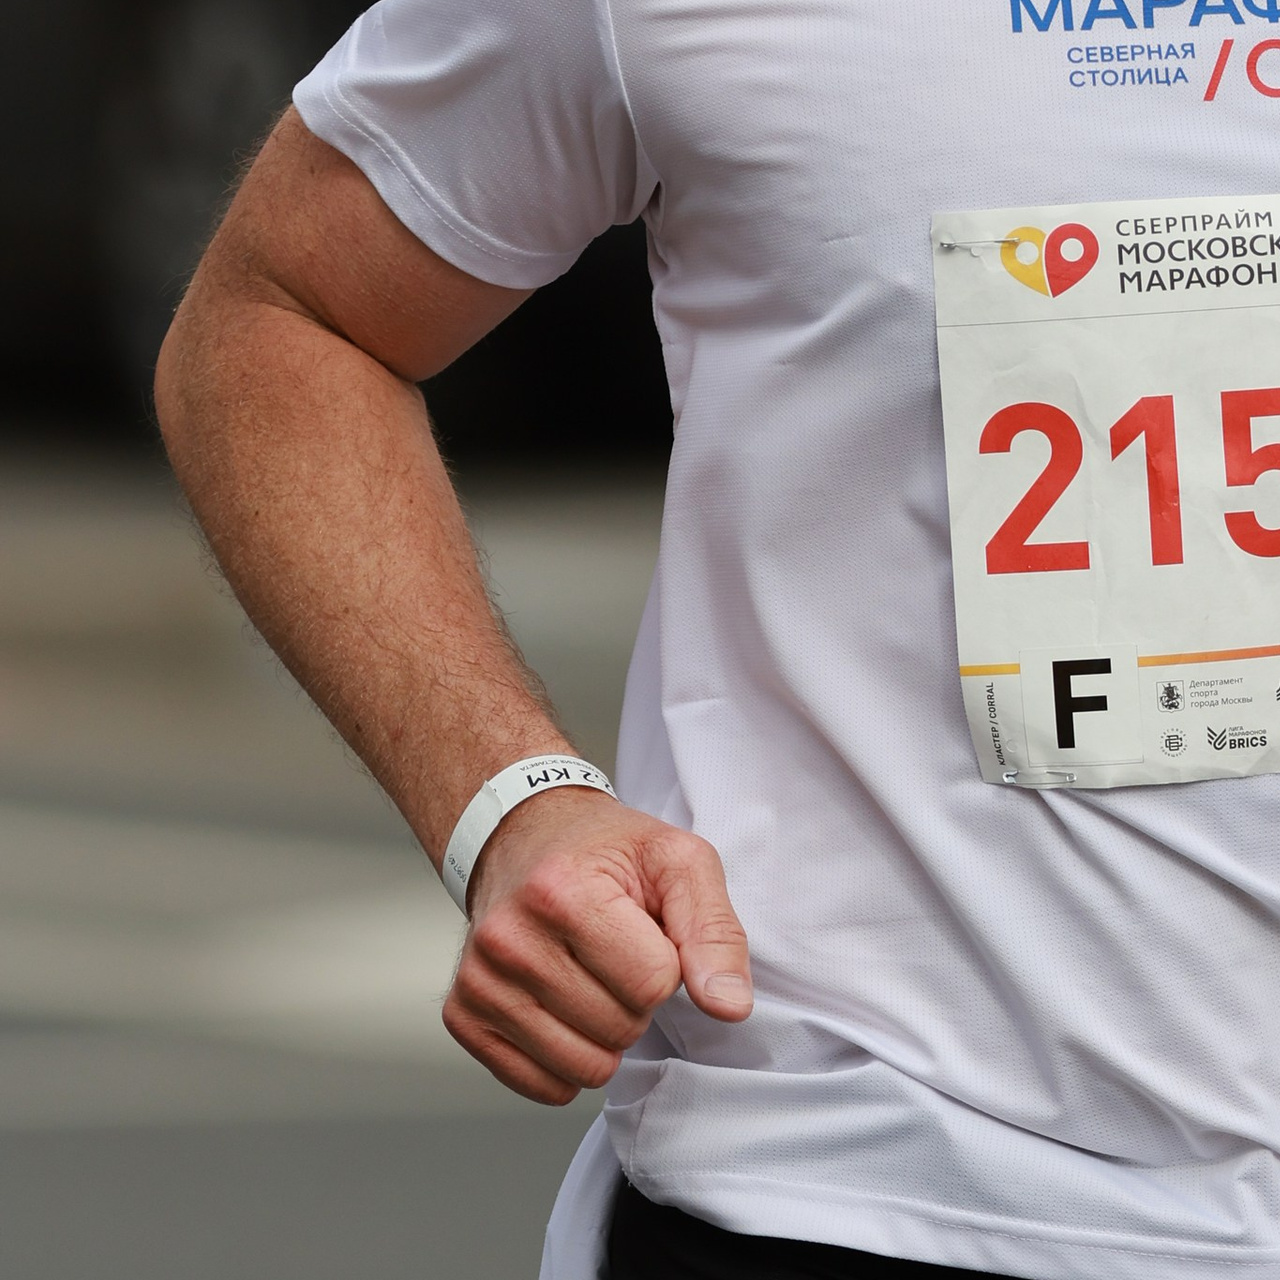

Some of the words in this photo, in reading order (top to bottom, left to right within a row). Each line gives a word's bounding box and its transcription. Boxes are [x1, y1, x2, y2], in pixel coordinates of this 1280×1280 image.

[1067, 43, 1196, 64] СЕВЕРНАЯ
[1069, 67, 1189, 87] СТОЛИЦА
[1116, 208, 1273, 236] СБЕРПРАЙМ
[1119, 262, 1278, 293] МАРАФОН
[1189, 677, 1243, 689] Департамент
[986, 682, 997, 719] CORRAL
[1052, 658, 1112, 749] F
[1190, 690, 1218, 698] спорта
[1190, 700, 1219, 708] города
[1221, 697, 1253, 705] Москвы
[991, 726, 1006, 766] КЛАСТЕР
[1229, 736, 1267, 749] BRICS
